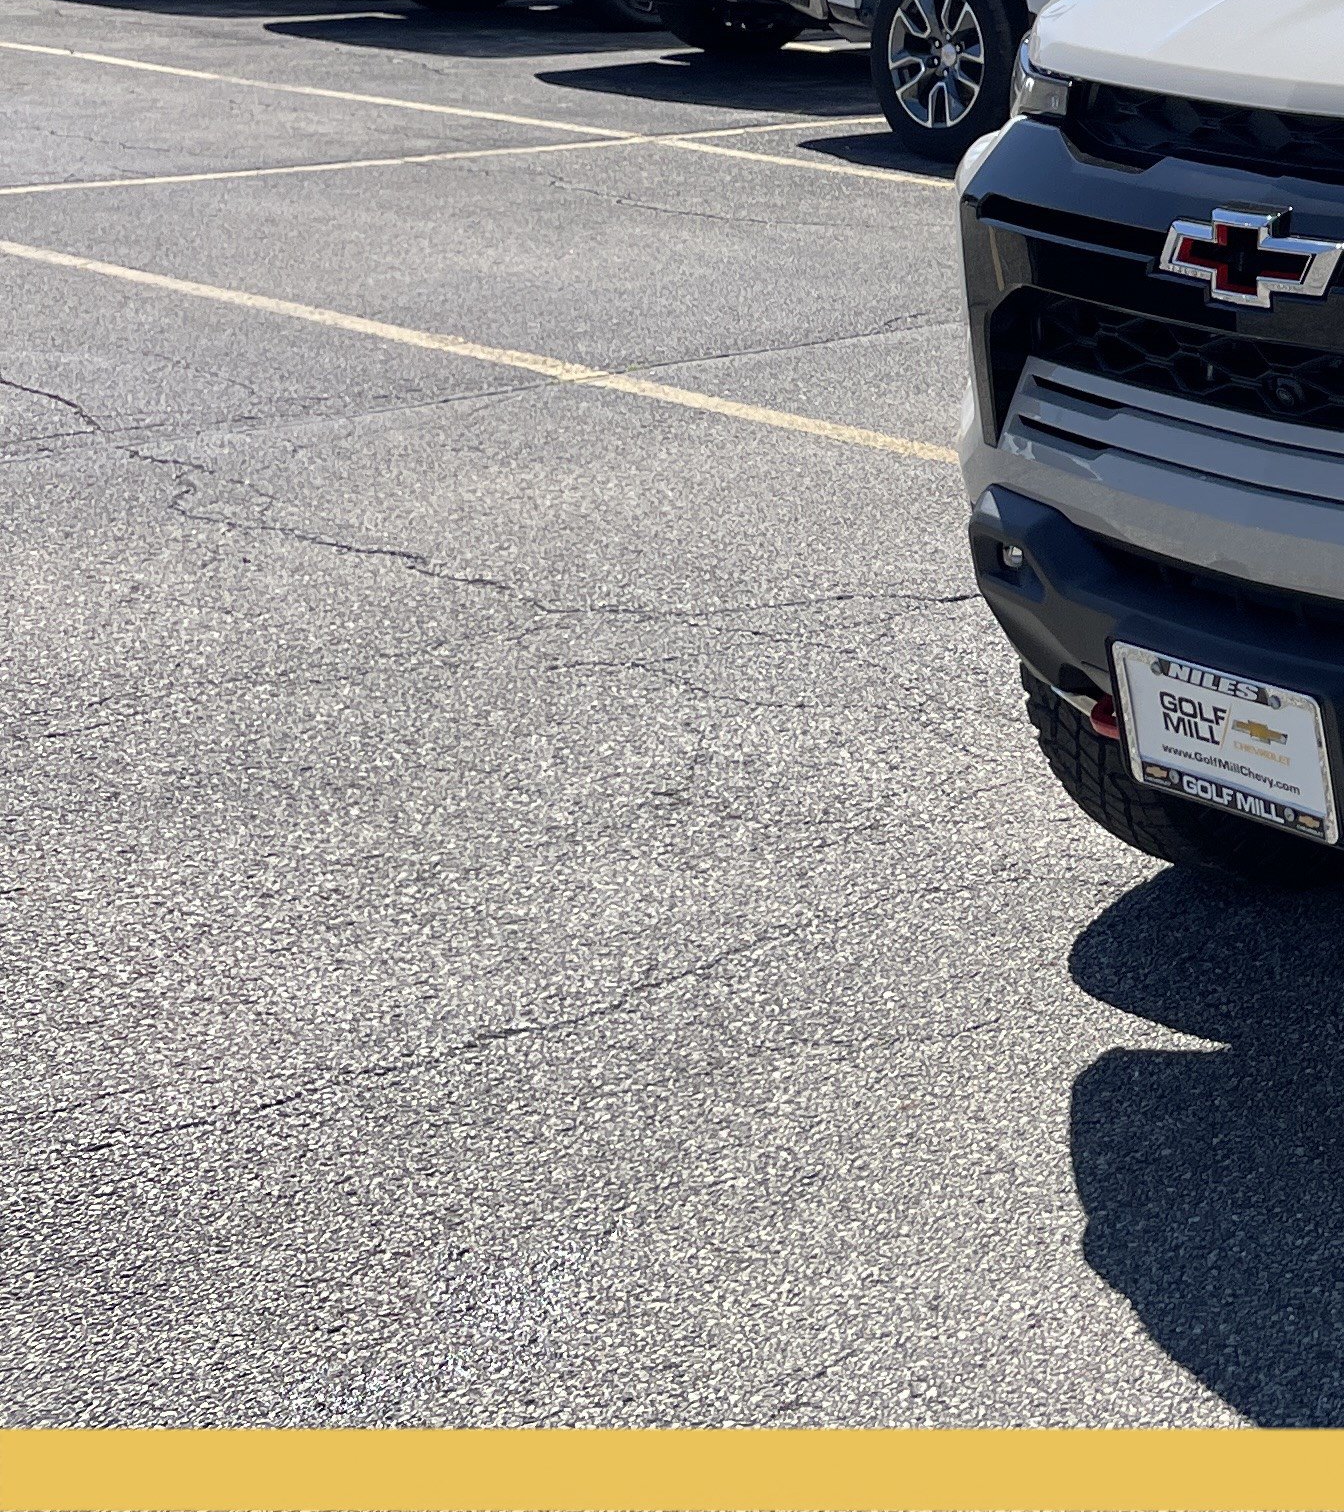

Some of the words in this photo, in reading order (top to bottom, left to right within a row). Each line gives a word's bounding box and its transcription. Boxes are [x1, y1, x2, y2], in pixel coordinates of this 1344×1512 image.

[1166, 662, 1259, 701] NILES
[1160, 692, 1227, 725] GOLF
[1163, 711, 1220, 745] MILL
[1162, 744, 1301, 796] www.GolfMillChevy.com
[1183, 774, 1234, 806] GOLF
[1236, 791, 1285, 824] MILL
